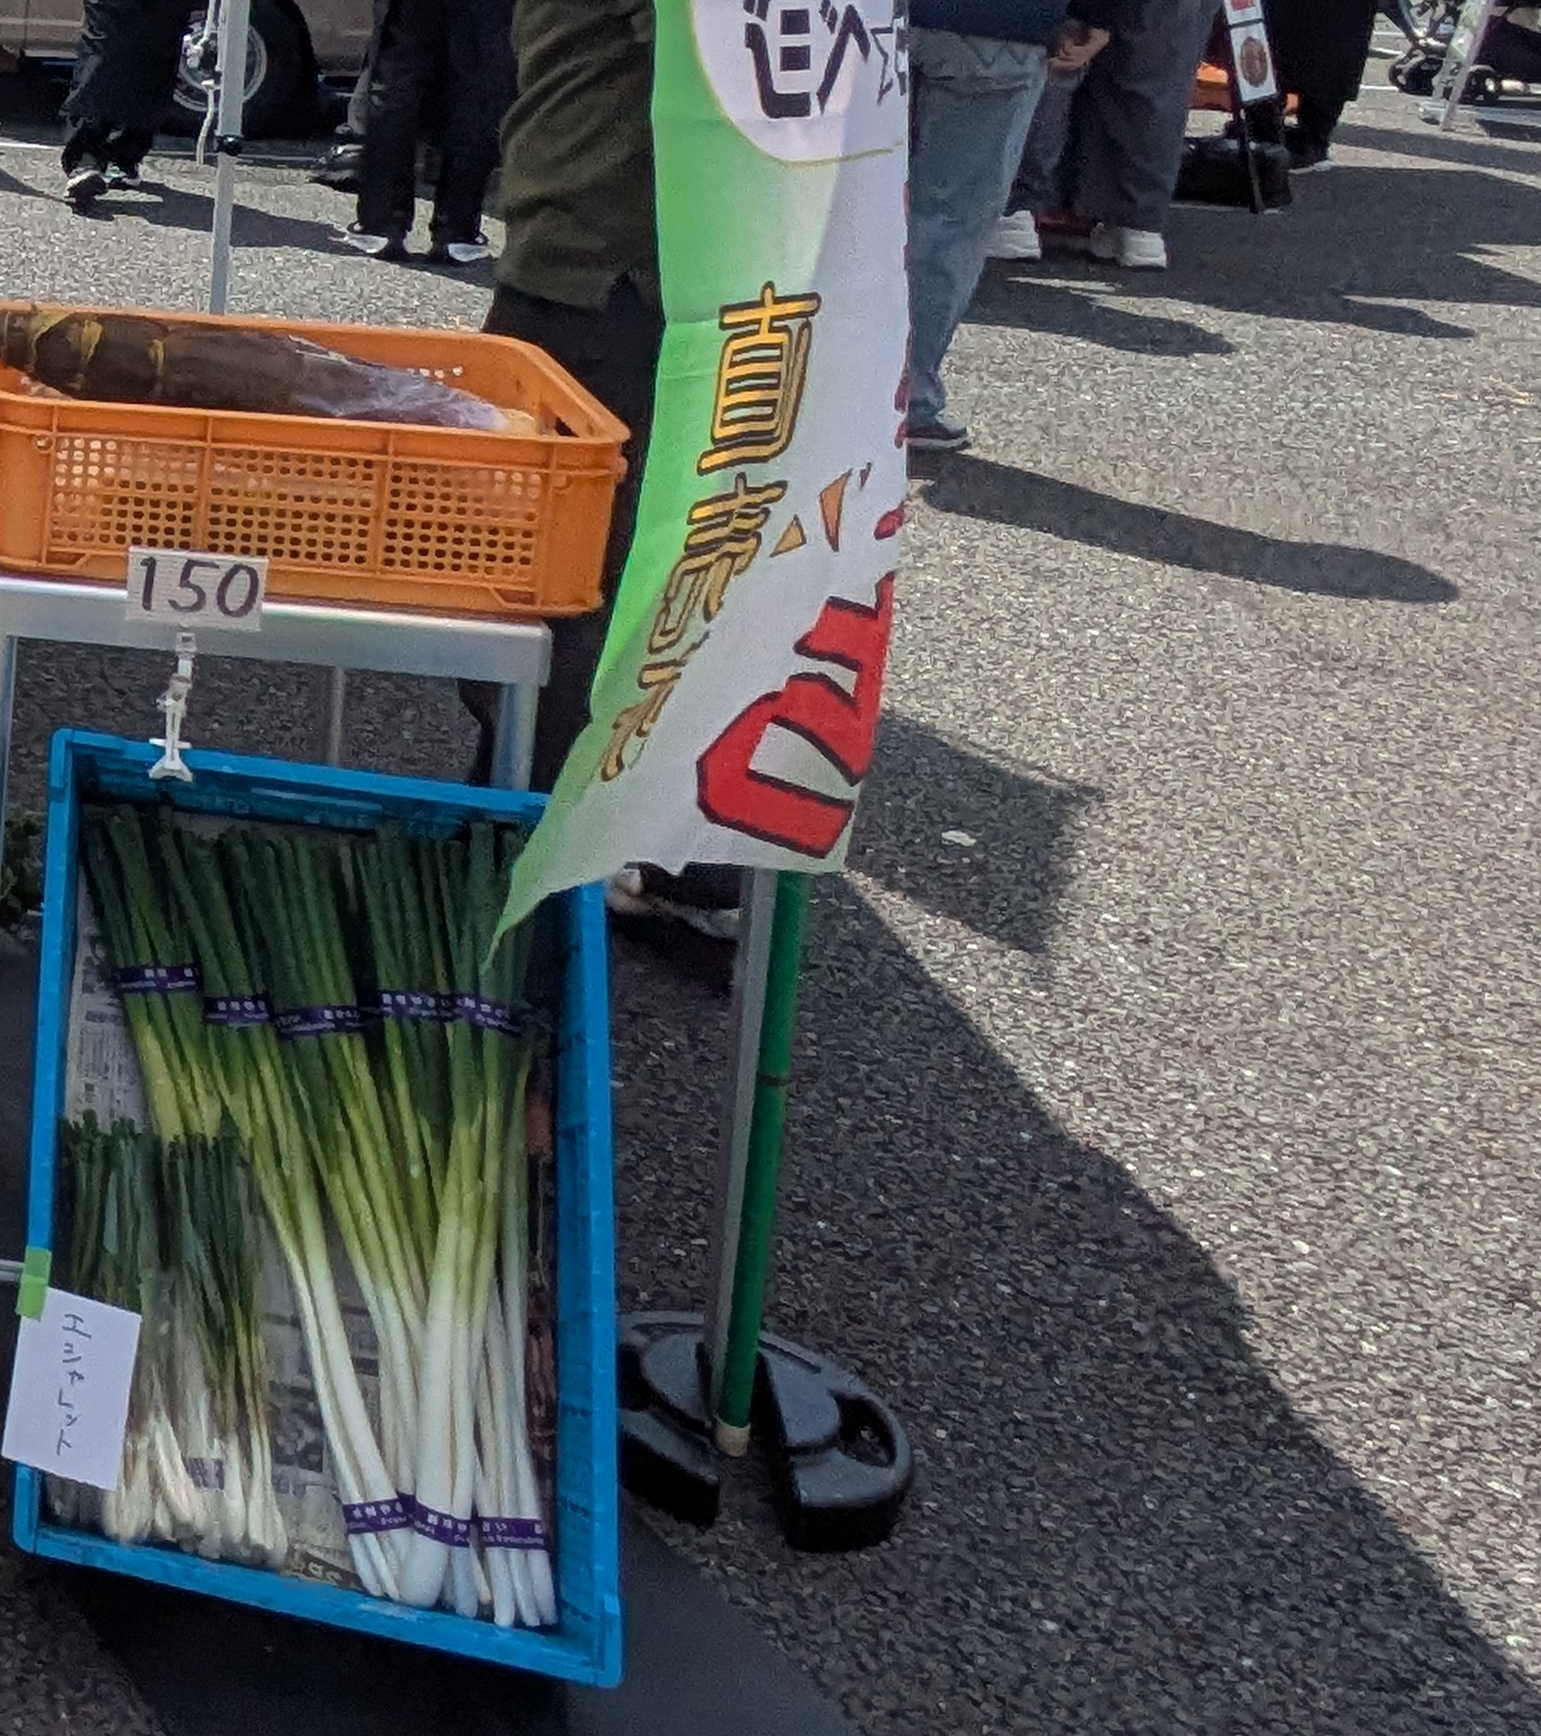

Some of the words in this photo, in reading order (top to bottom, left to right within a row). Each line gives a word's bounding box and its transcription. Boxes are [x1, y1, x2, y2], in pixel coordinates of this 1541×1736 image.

[136, 557, 262, 618] 150
[56, 1313, 92, 1456] エシャレット
